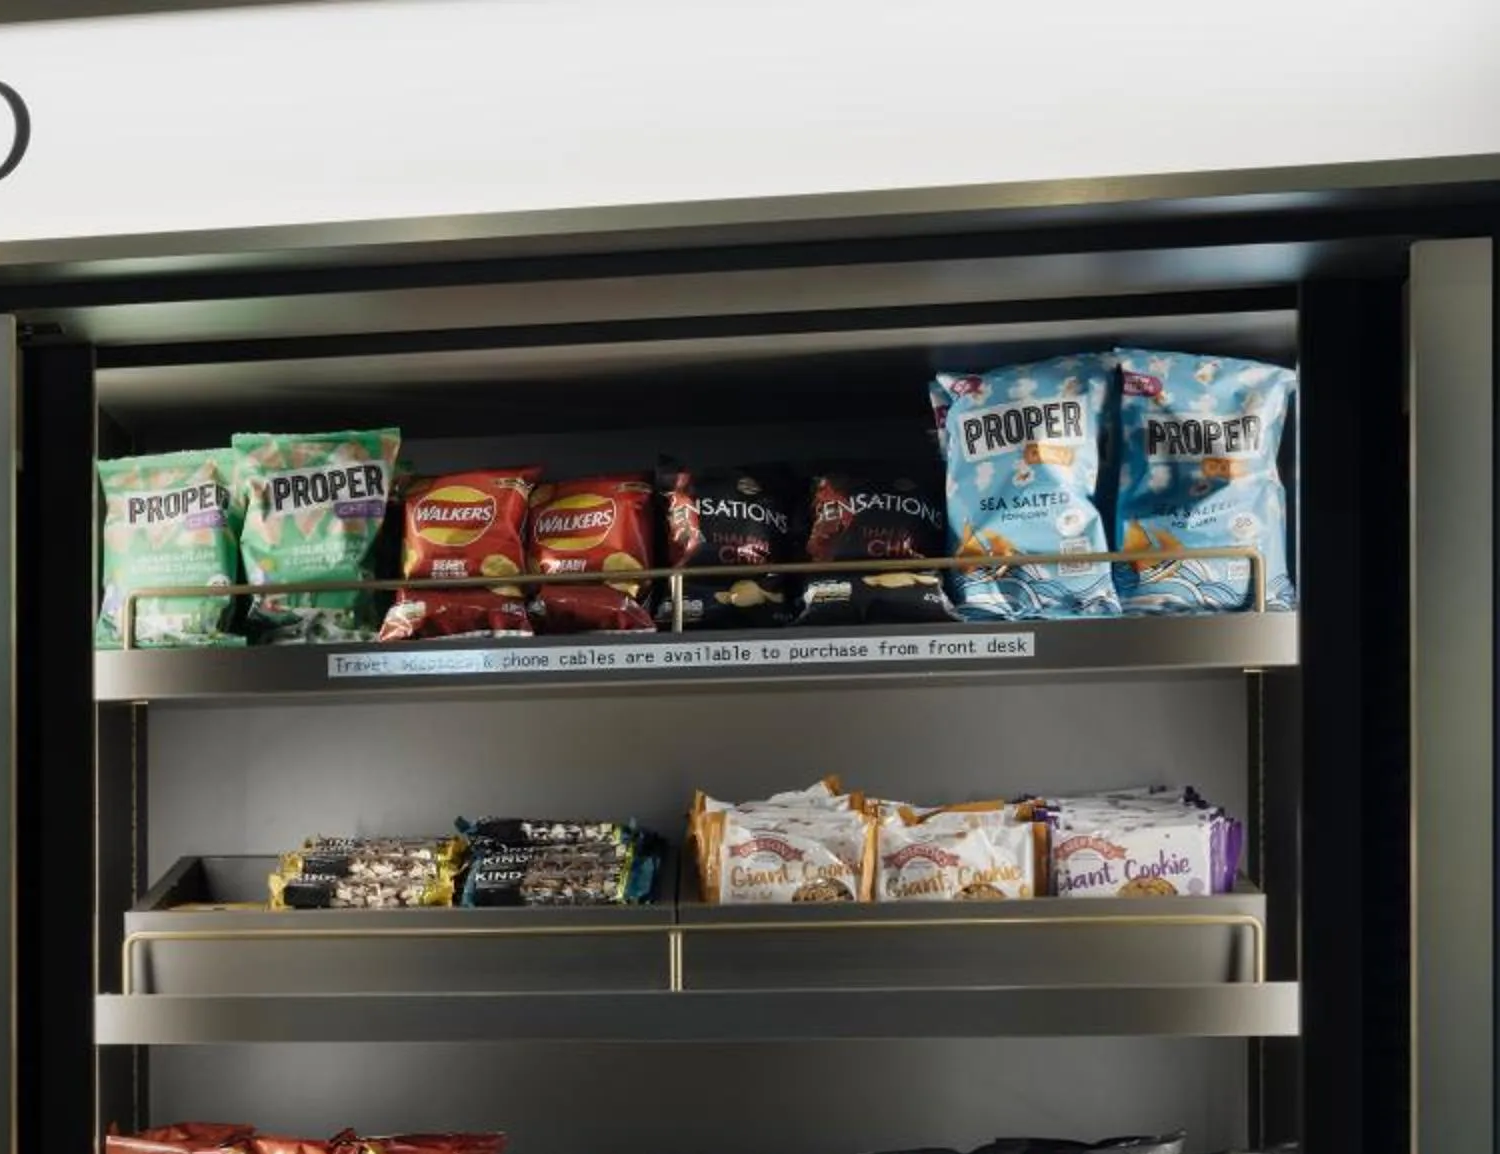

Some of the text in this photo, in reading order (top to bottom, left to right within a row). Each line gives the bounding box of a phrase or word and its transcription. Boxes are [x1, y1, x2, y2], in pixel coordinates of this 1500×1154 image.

[963, 402, 1082, 454] PROPER
[1148, 415, 1261, 455] PROPER
[272, 464, 384, 511] PROPER
[980, 492, 1070, 511] SEA SALTED
[416, 503, 494, 522] WALKERS
[537, 509, 613, 533] WALKERS
[503, 651, 549, 672] phone
[559, 649, 615, 666] cables
[625, 651, 655, 664] are
[664, 645, 750, 664] available
[762, 646, 780, 661] to
[789, 642, 868, 661] purchase
[879, 641, 919, 657] from
[928, 640, 977, 656] front
[987, 638, 1027, 654] desk
[474, 871, 523, 882] KIND
[1124, 850, 1191, 879] Cookie
